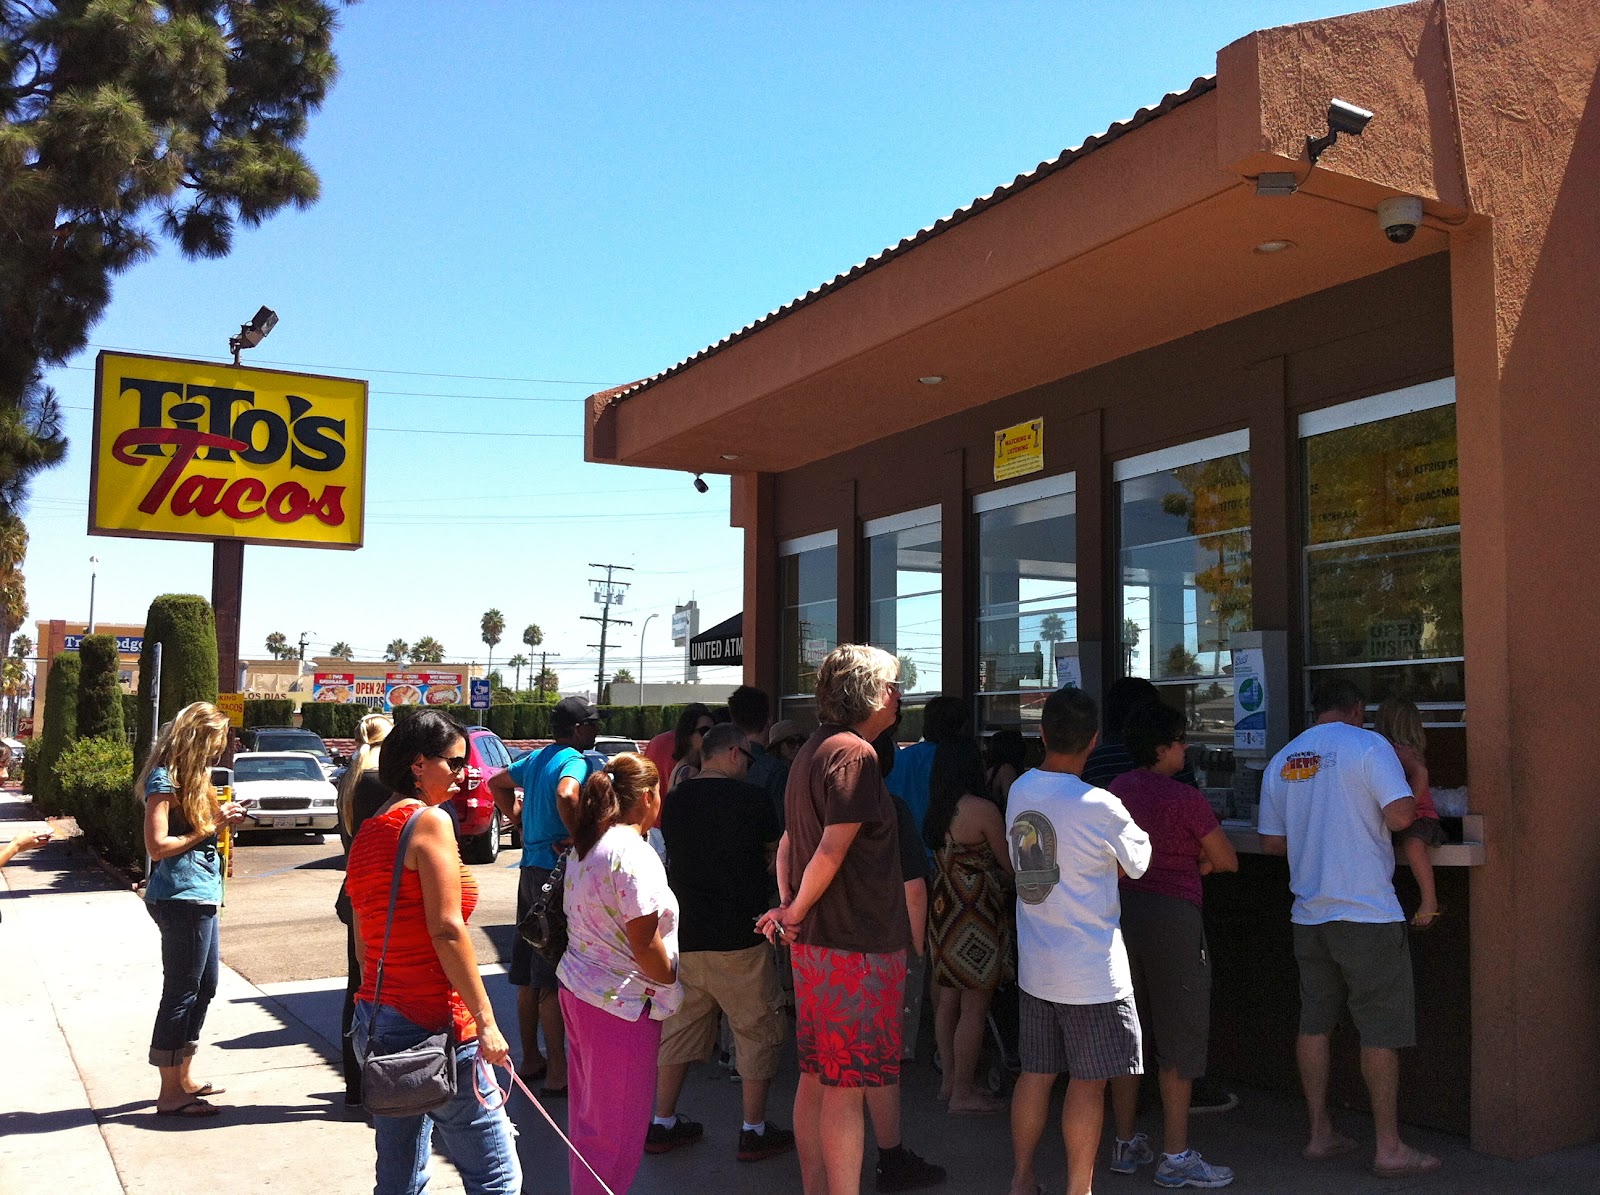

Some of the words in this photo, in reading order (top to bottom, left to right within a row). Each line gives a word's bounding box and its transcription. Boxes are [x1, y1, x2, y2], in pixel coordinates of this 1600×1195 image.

[112, 427, 347, 527] Tacos
[691, 639, 722, 661] UNITED
[724, 636, 744, 658] ATM
[355, 682, 375, 695] OPEN
[376, 682, 385, 695] 24
[261, 692, 287, 701] DIAS
[355, 696, 385, 708] HOURS
[220, 702, 243, 713] TACOS
